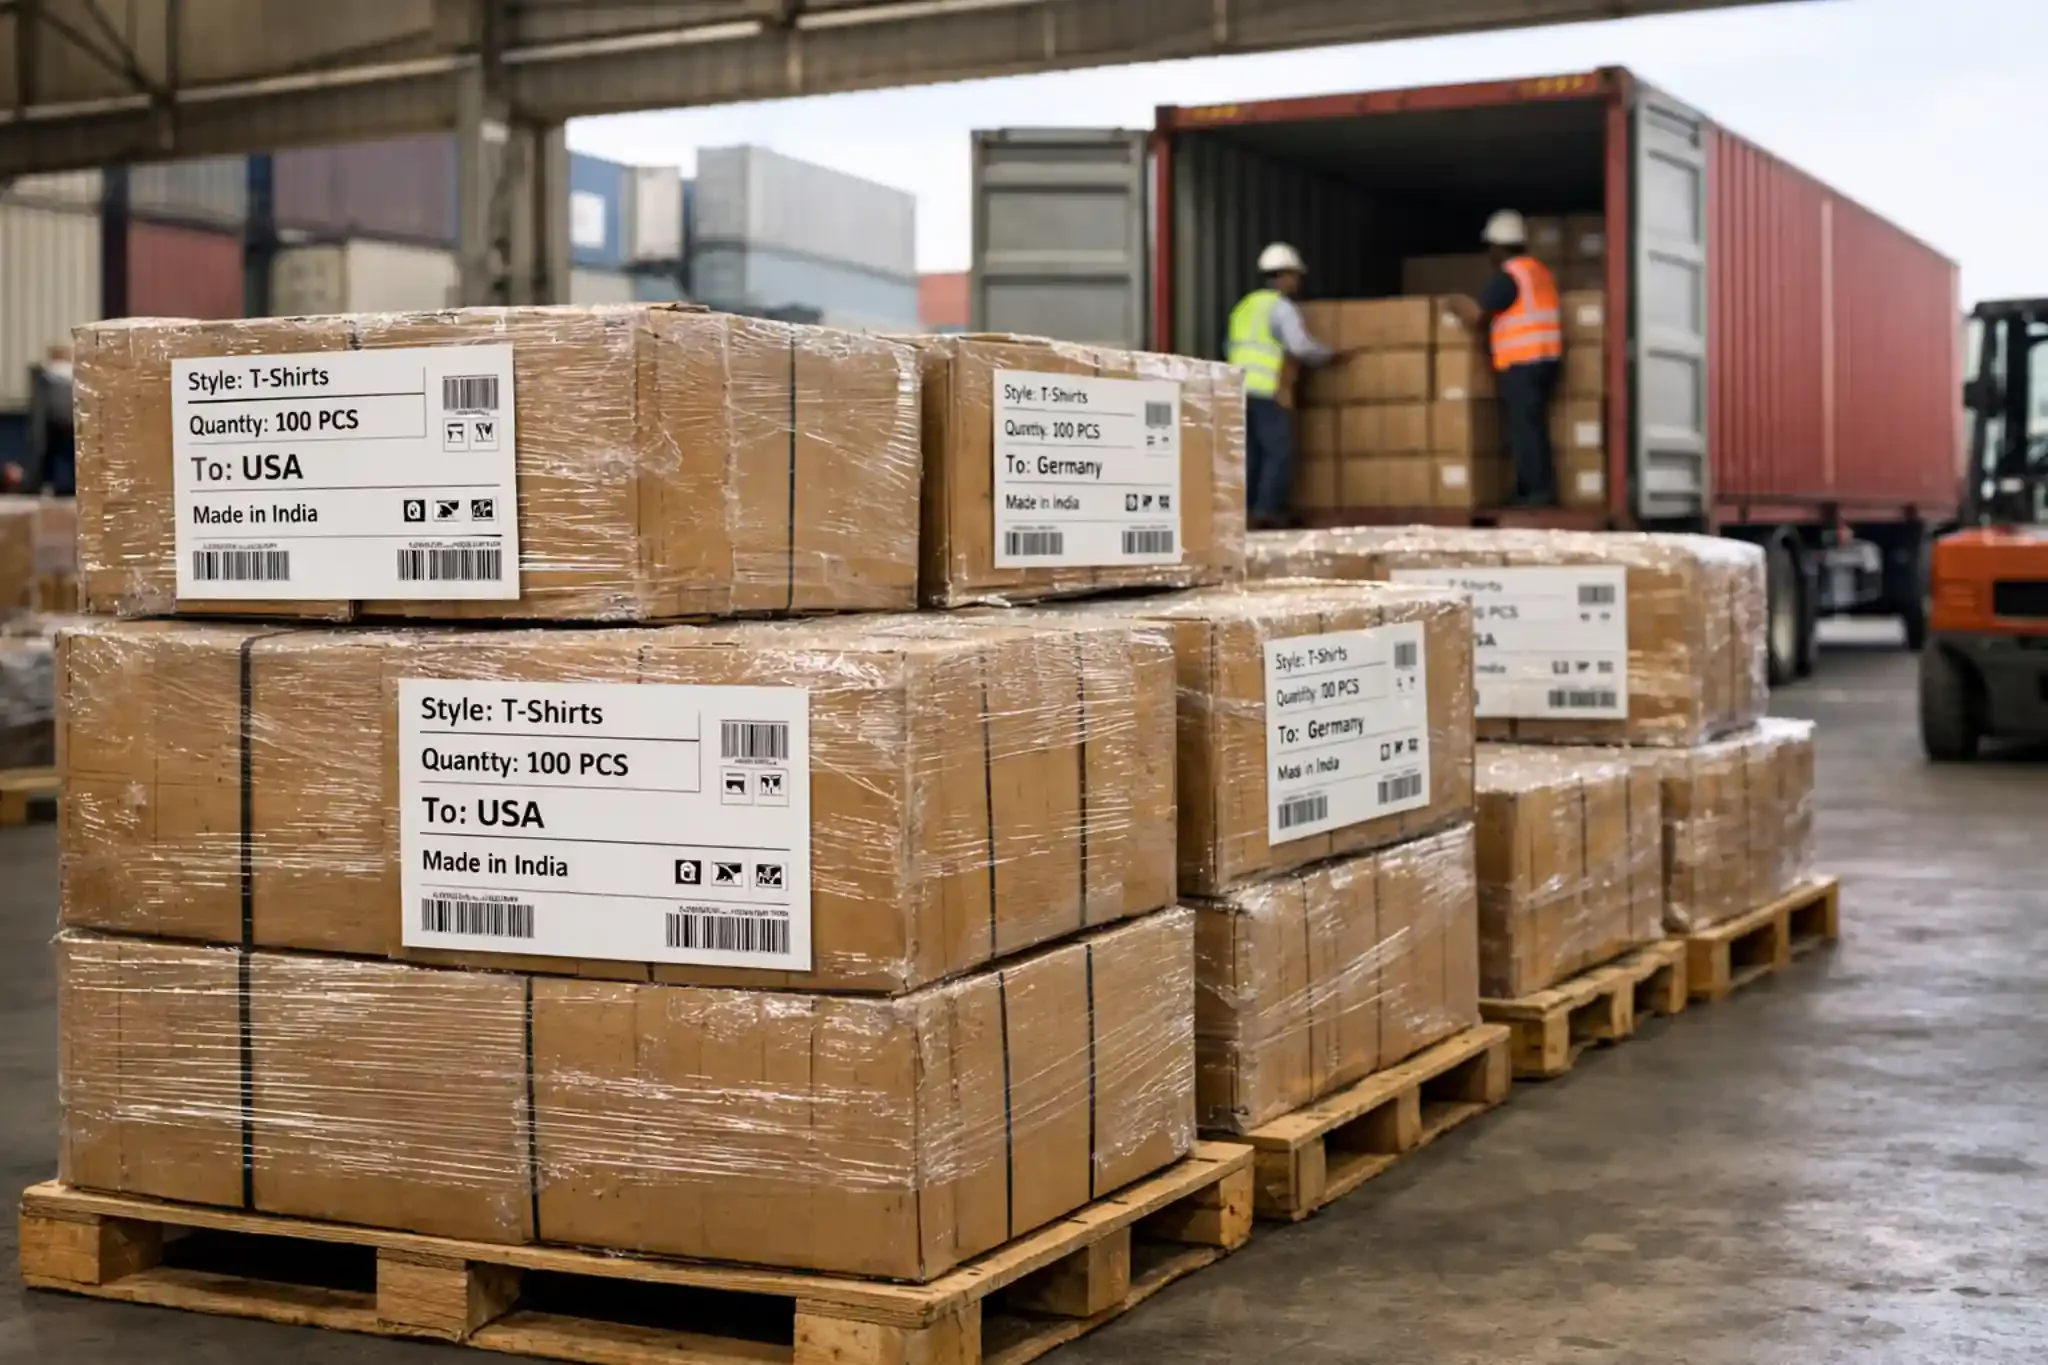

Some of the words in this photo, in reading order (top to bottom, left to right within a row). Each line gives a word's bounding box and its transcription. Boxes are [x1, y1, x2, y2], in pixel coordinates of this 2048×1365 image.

[188, 370, 242, 395] Style:
[249, 367, 329, 388] T-Shirts
[1005, 384, 1036, 404] Style:
[1041, 386, 1088, 404] T-Shirts
[276, 411, 311, 432] 100
[319, 409, 359, 430] PCS
[1053, 422, 1074, 438] 100
[1077, 423, 1100, 439] PCS
[191, 457, 231, 481] To:
[243, 454, 303, 480] USA
[1006, 454, 1030, 474] To:
[1037, 456, 1102, 479] Germany
[194, 505, 243, 524] Made
[250, 505, 266, 523] in
[273, 504, 317, 523] India
[1276, 652, 1304, 672] Style:
[1308, 646, 1347, 665] T-Shirts
[1338, 678, 1359, 696] PCS
[422, 697, 492, 726] Style:
[501, 699, 603, 724] T-Shirts
[1278, 725, 1299, 744] To:
[1308, 718, 1363, 739] Germany
[528, 752, 570, 775] 100
[580, 753, 628, 776] PCS
[422, 797, 466, 824] To:
[478, 799, 544, 828] USA
[423, 850, 480, 873] Made
[489, 853, 506, 873] in
[516, 855, 568, 876] India
